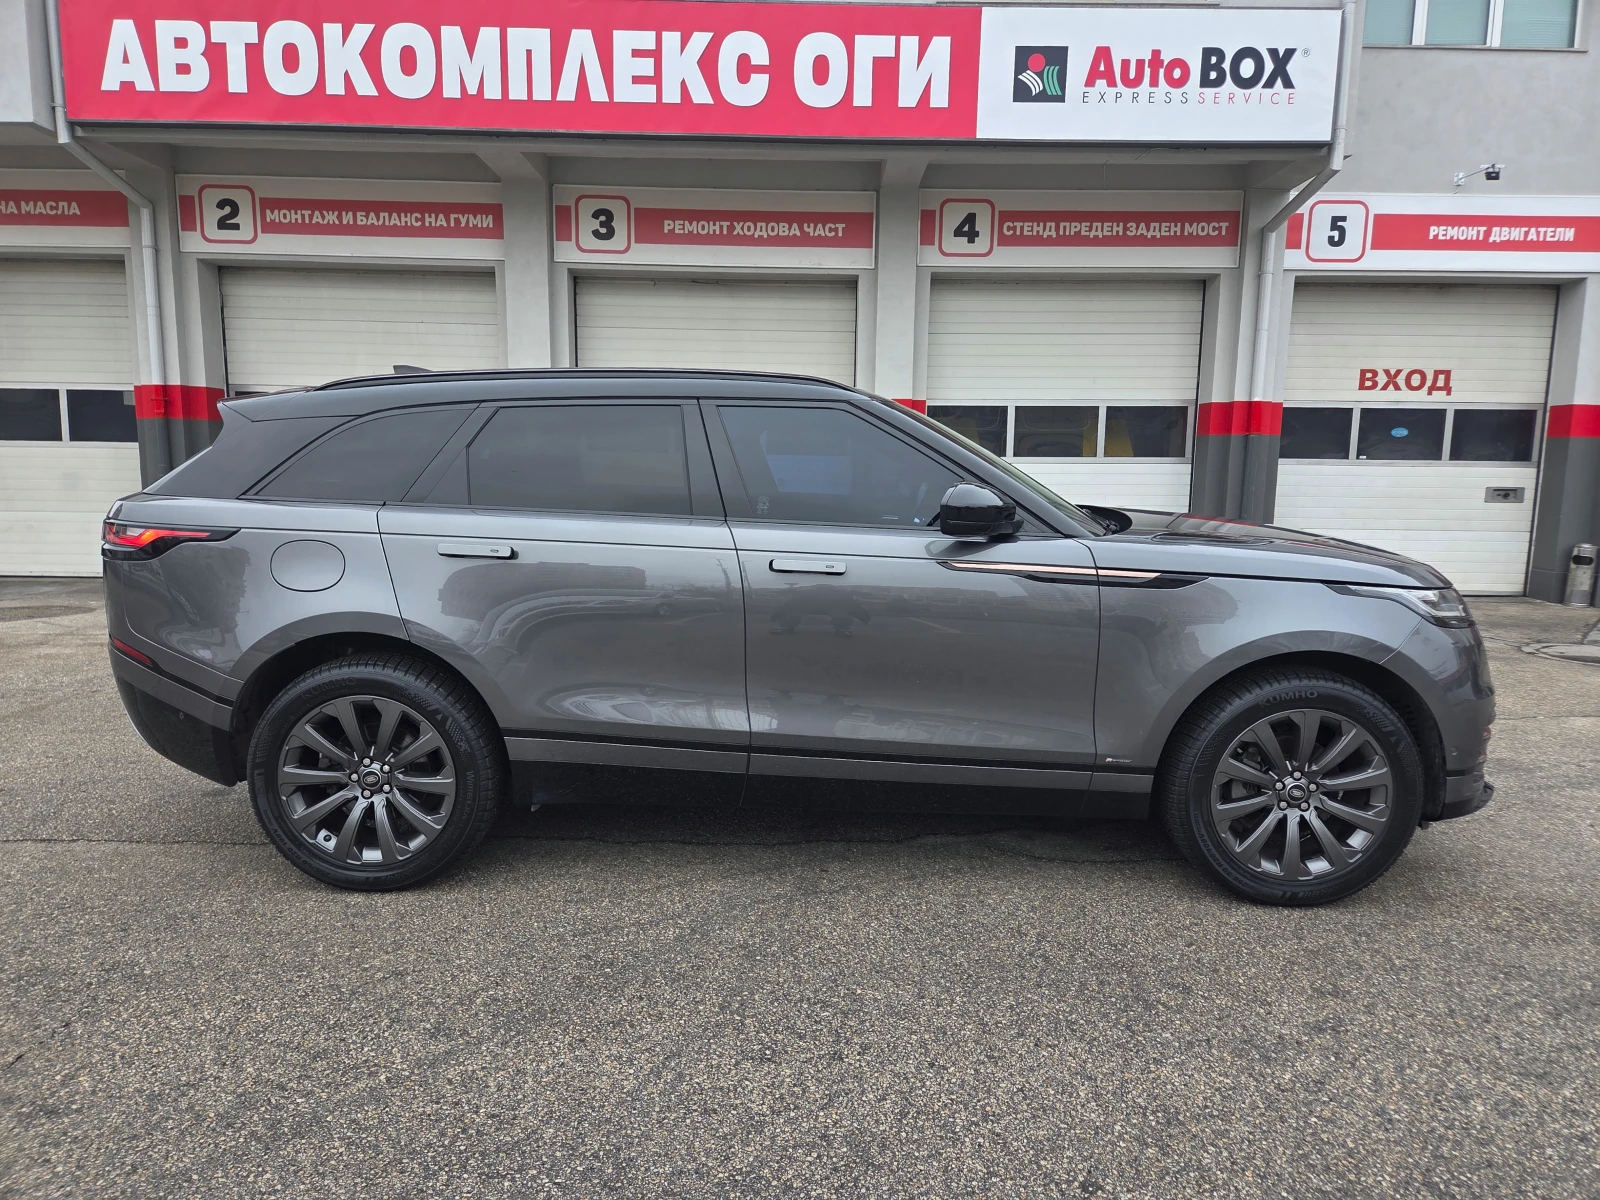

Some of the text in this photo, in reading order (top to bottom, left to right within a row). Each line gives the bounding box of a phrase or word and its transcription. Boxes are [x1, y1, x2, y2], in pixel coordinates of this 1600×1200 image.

[100, 19, 951, 108] АВТОКОМПЛЕКС ОГИ
[1083, 45, 1191, 89] Auto
[1082, 91, 1296, 105] EXPRESS SERVICE
[21, 201, 81, 215] МАСЛА
[215, 197, 241, 231] 2
[265, 208, 494, 228] МОНТАЖ И БАЛАНС НА ГУМИ
[590, 207, 616, 241] 3
[663, 219, 846, 238] РЕМОНТ ХОДОВА ЧАСТ
[953, 212, 980, 244] 4
[1003, 221, 1229, 238] СТЕНД ПРЕДЕН ЗАДЕН МОСТ
[1327, 215, 1348, 248] 5
[1429, 225, 1576, 243] РЕМОНТ ДВИГАТЕЛИ
[1357, 368, 1453, 396] ВХОД
[1259, 689, 1318, 706] KUMHO
